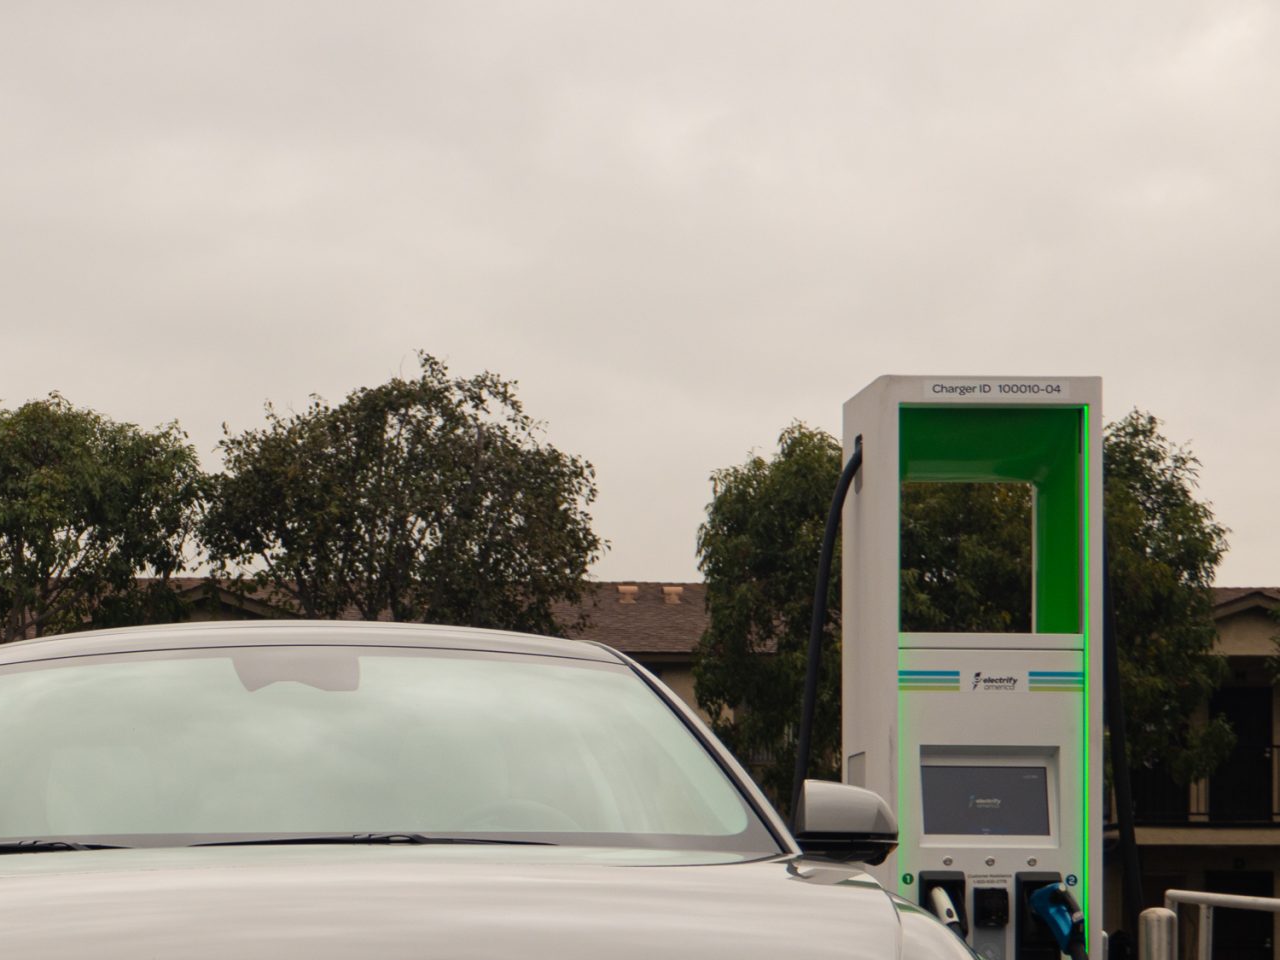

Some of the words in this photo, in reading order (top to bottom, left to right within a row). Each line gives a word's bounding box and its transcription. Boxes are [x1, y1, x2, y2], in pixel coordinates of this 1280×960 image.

[932, 384, 977, 396] Charger
[979, 384, 992, 394] ID
[998, 384, 1061, 394] 100010-04
[983, 676, 1018, 686] electrify
